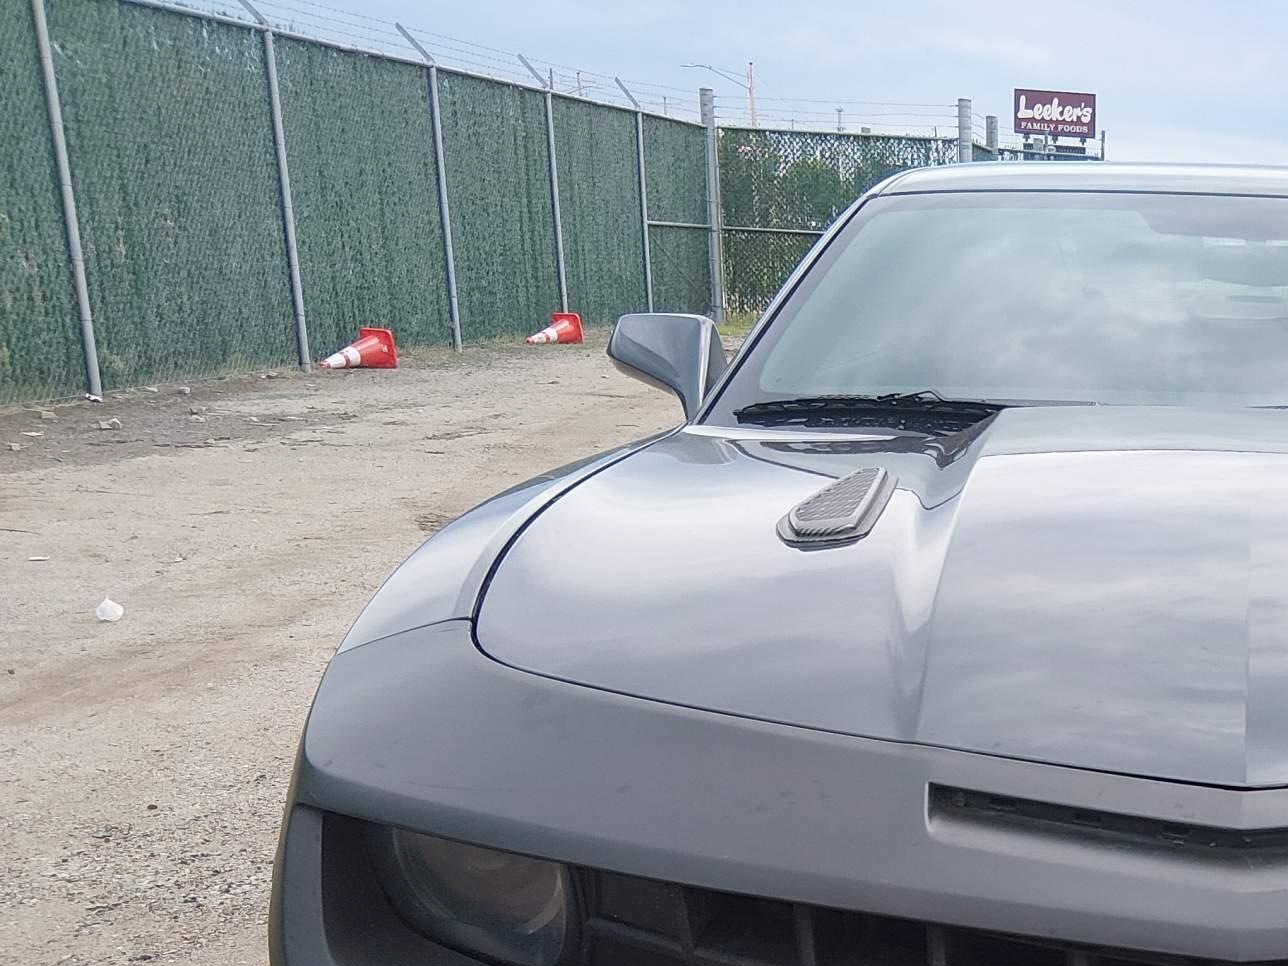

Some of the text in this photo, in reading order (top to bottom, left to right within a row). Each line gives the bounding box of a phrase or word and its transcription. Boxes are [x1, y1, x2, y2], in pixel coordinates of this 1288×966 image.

[1017, 95, 1092, 123] Leeker's
[1021, 122, 1088, 133] FAMILY FOODS
